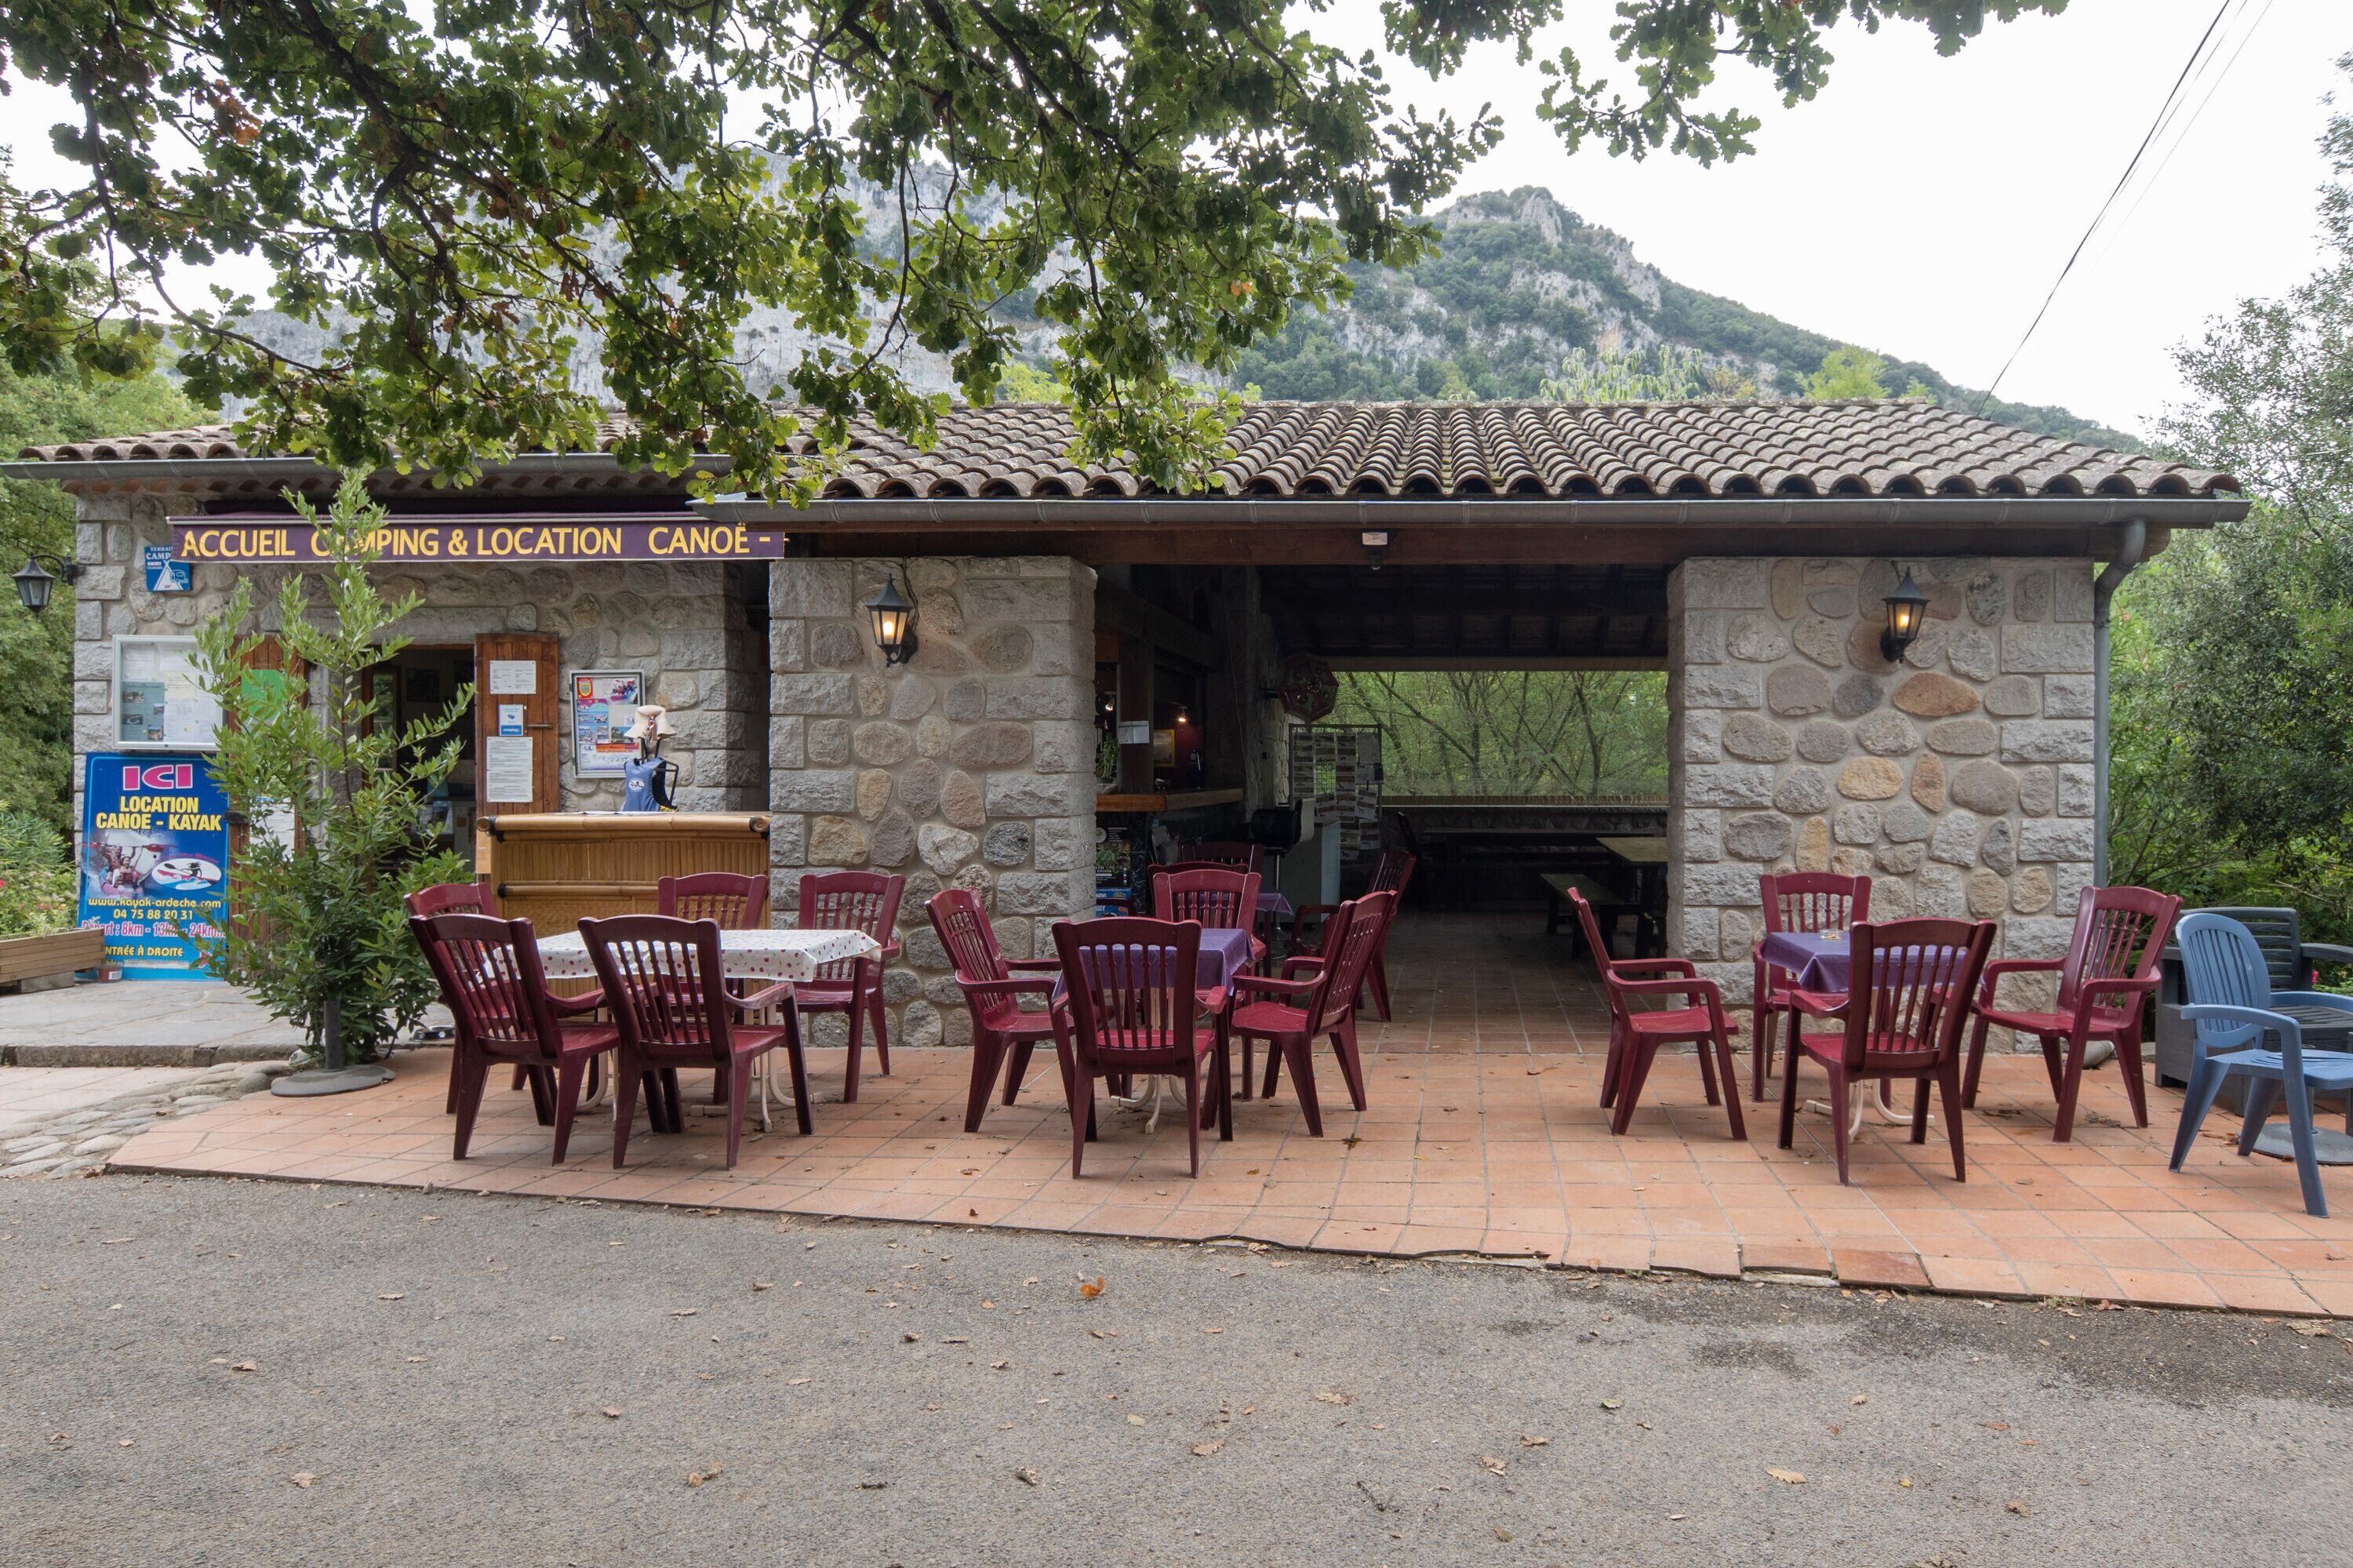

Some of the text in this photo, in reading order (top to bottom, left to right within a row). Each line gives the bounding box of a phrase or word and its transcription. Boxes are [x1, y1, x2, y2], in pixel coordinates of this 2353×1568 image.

[181, 529, 296, 557] ACCUEIL
[311, 528, 438, 557] CMPING
[448, 529, 468, 556] &
[477, 526, 622, 555] LOCATION
[648, 522, 750, 555] CANOË
[122, 764, 193, 791] ICI
[120, 796, 198, 813] LOCATION
[96, 813, 151, 829] CANOE
[168, 815, 222, 831] KAYAK
[88, 897, 221, 909] www.kayak-ardeche.com
[113, 909, 193, 920] 04 75 88 20 31
[122, 921, 144, 936] 8km
[104, 944, 184, 957] NTRÉE À DROITE
